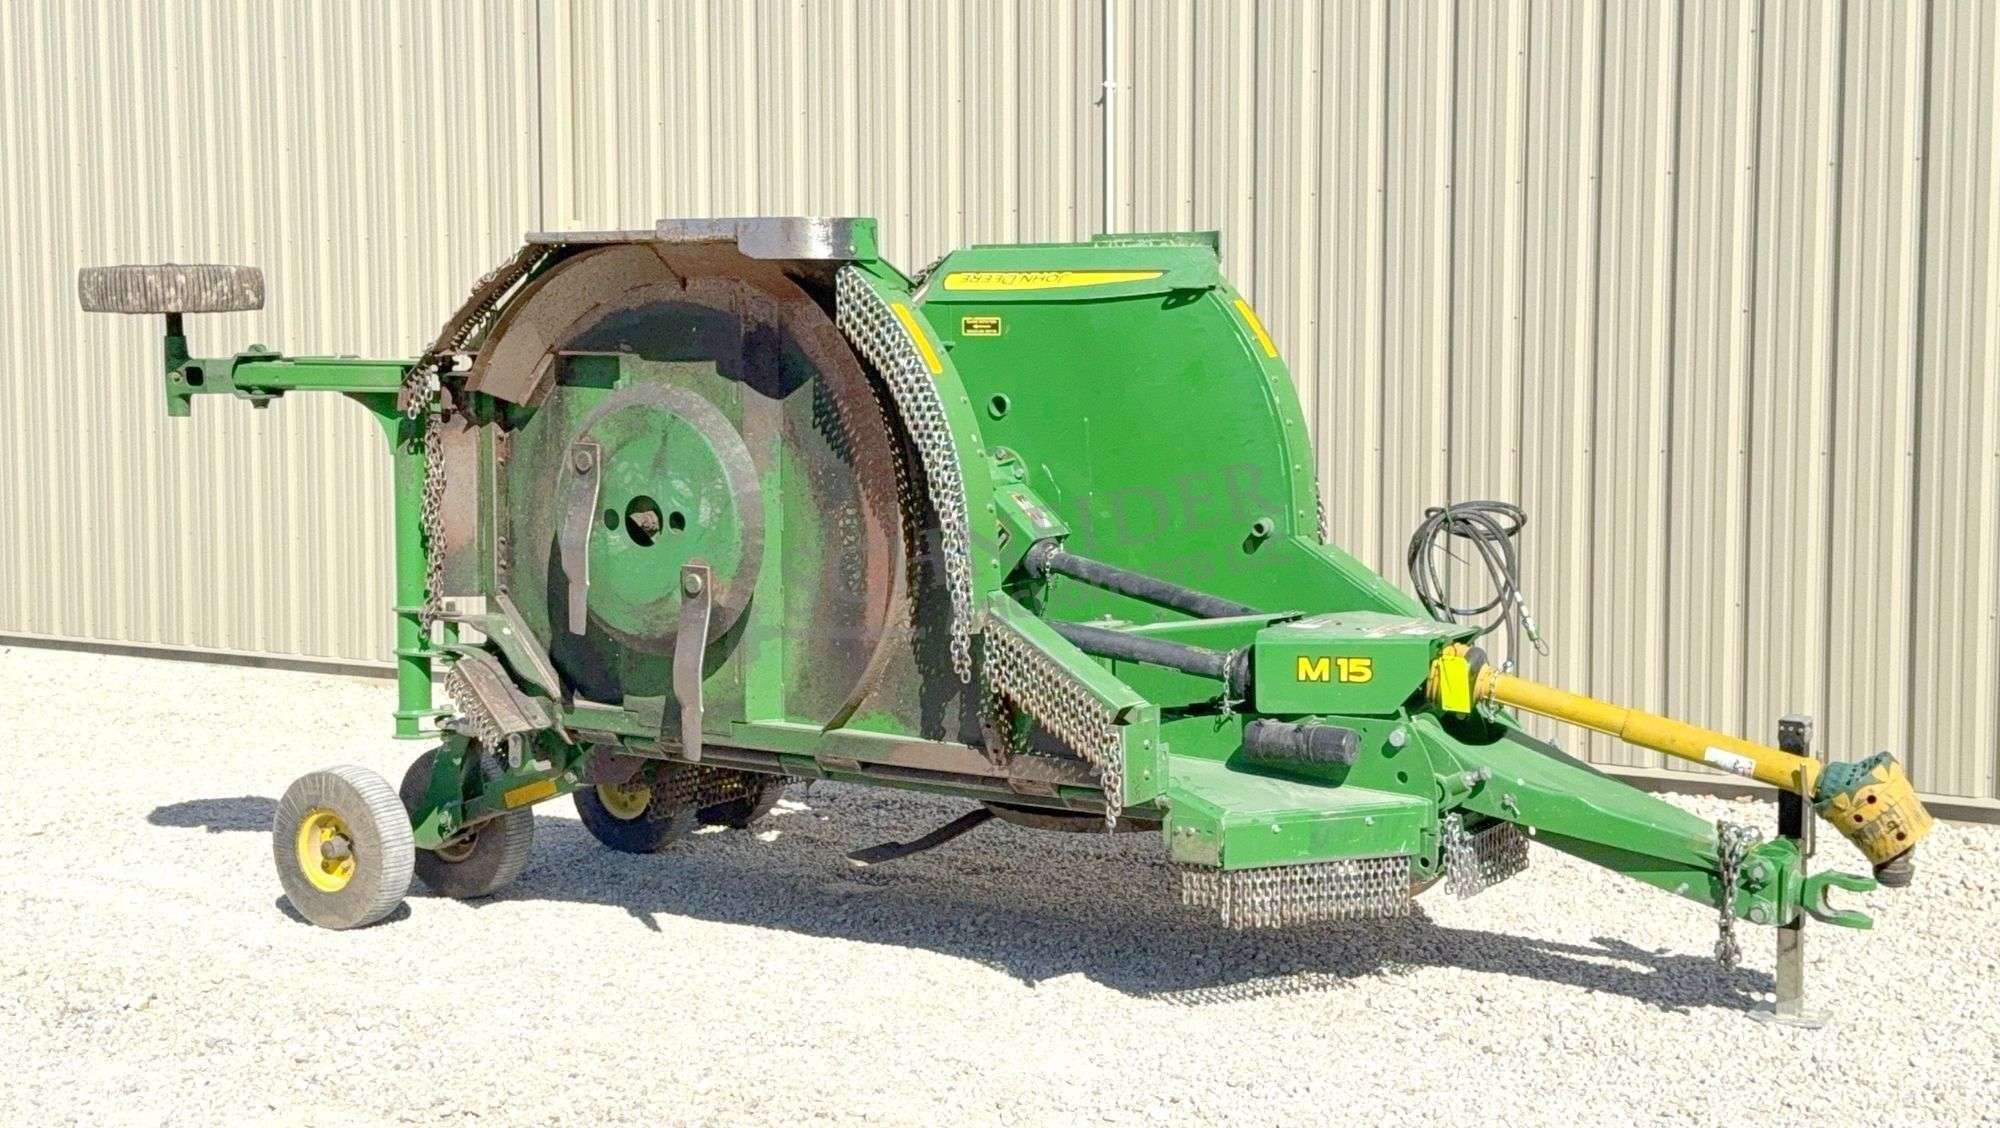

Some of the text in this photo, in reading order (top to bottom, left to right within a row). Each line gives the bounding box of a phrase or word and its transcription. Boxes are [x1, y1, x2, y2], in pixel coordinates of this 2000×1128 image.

[961, 272, 1070, 285] JOHN DEERE
[1297, 655, 1373, 683] M 15
